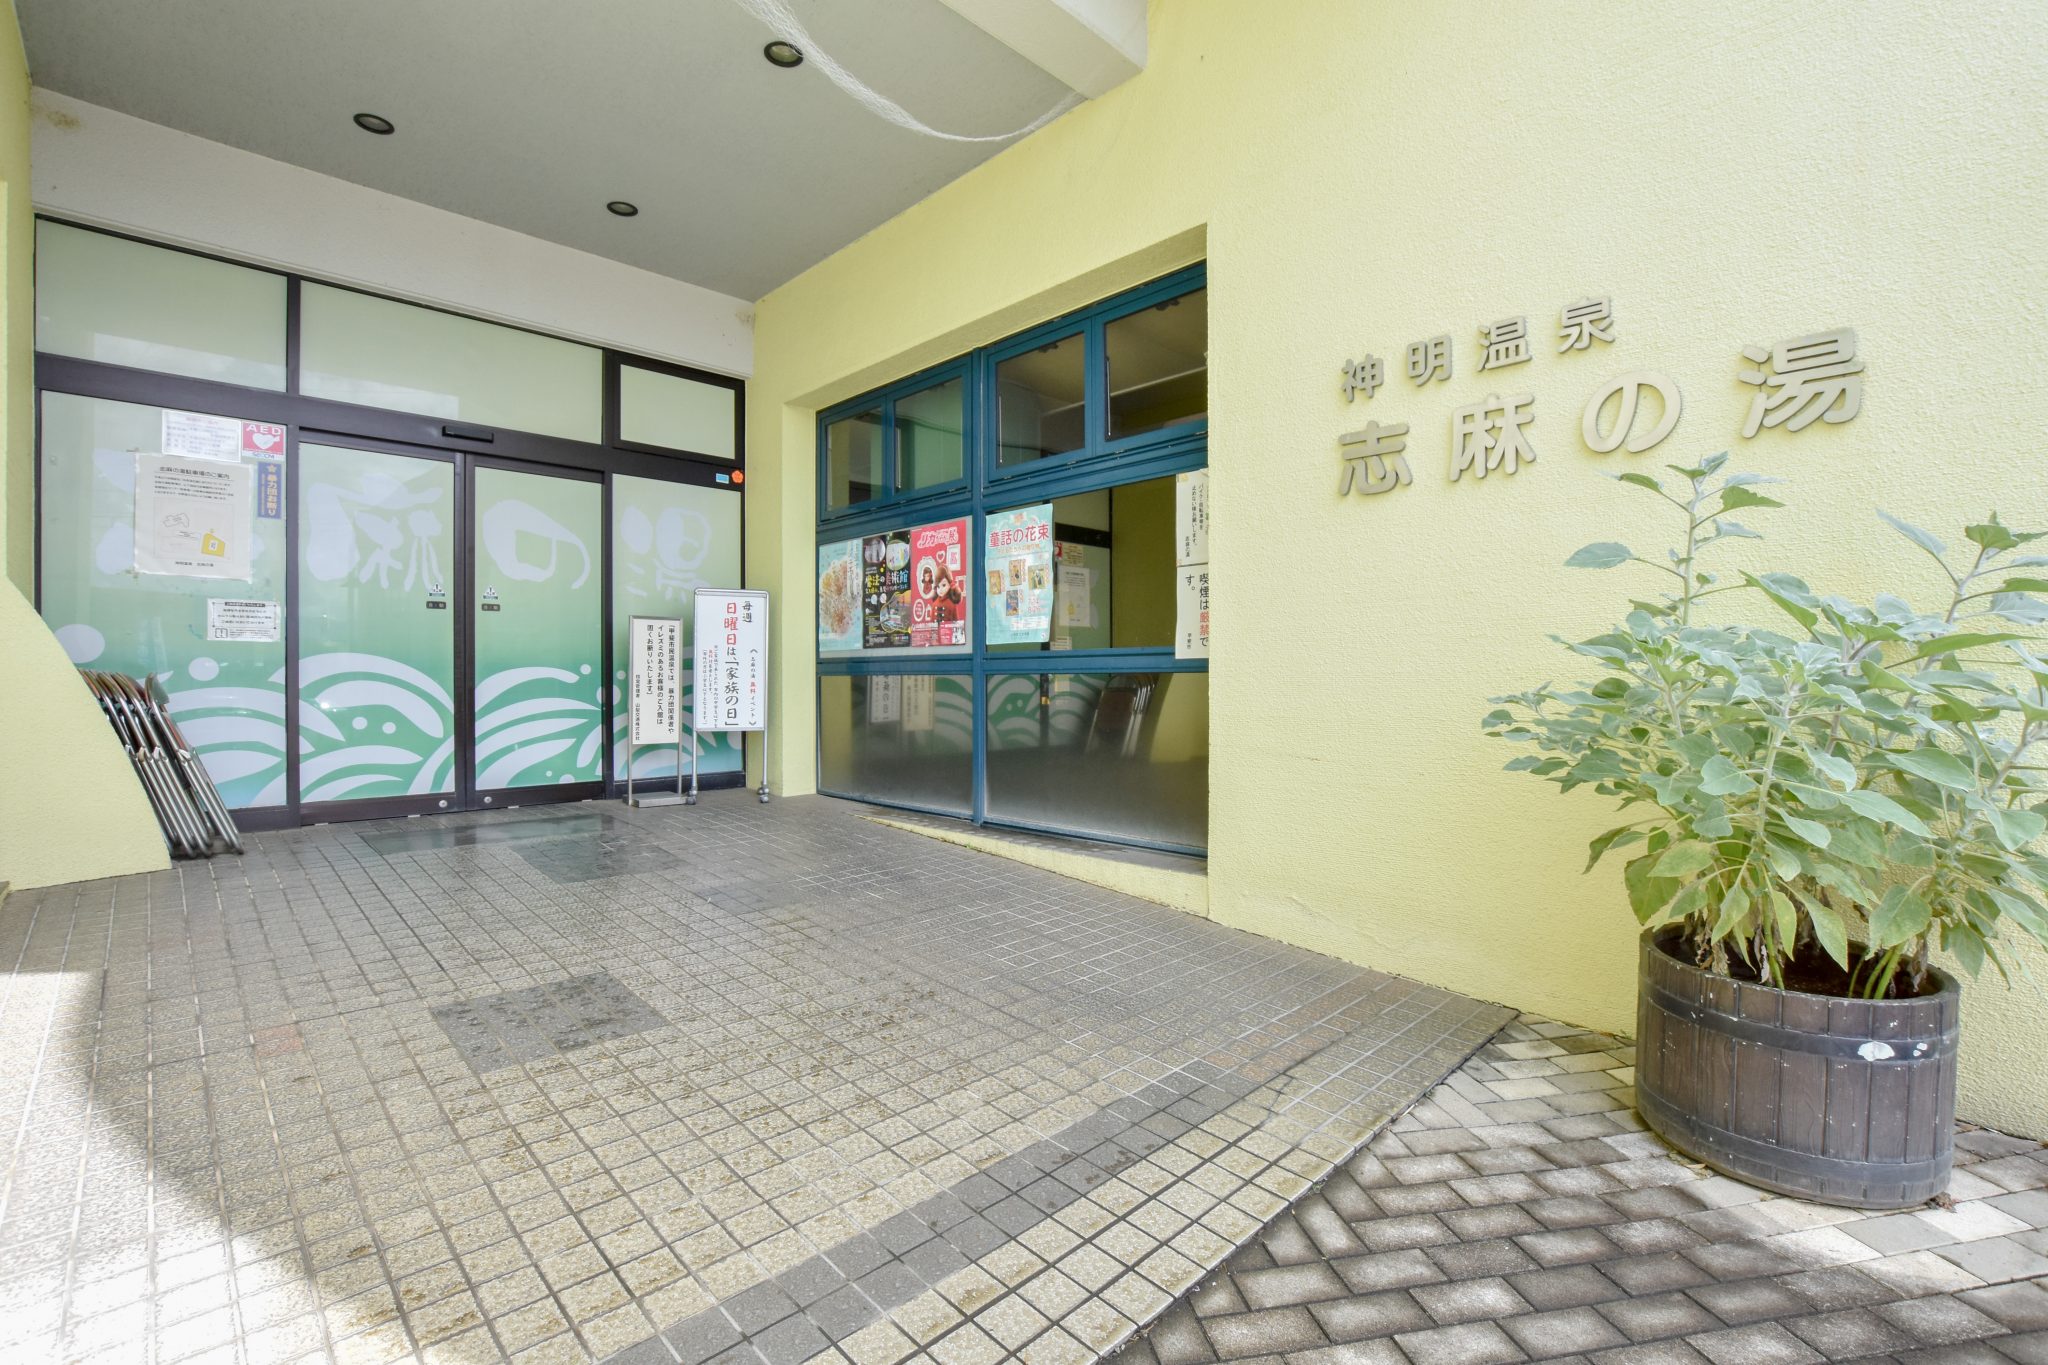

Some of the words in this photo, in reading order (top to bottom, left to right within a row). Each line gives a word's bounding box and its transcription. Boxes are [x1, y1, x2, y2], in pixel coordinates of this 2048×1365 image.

[1341, 296, 1615, 403] 神明温泉
[1337, 327, 1865, 496] 志麻の湯
[246, 423, 282, 436] AED
[989, 523, 1049, 548] 童話の花束
[742, 600, 753, 623] 毎週
